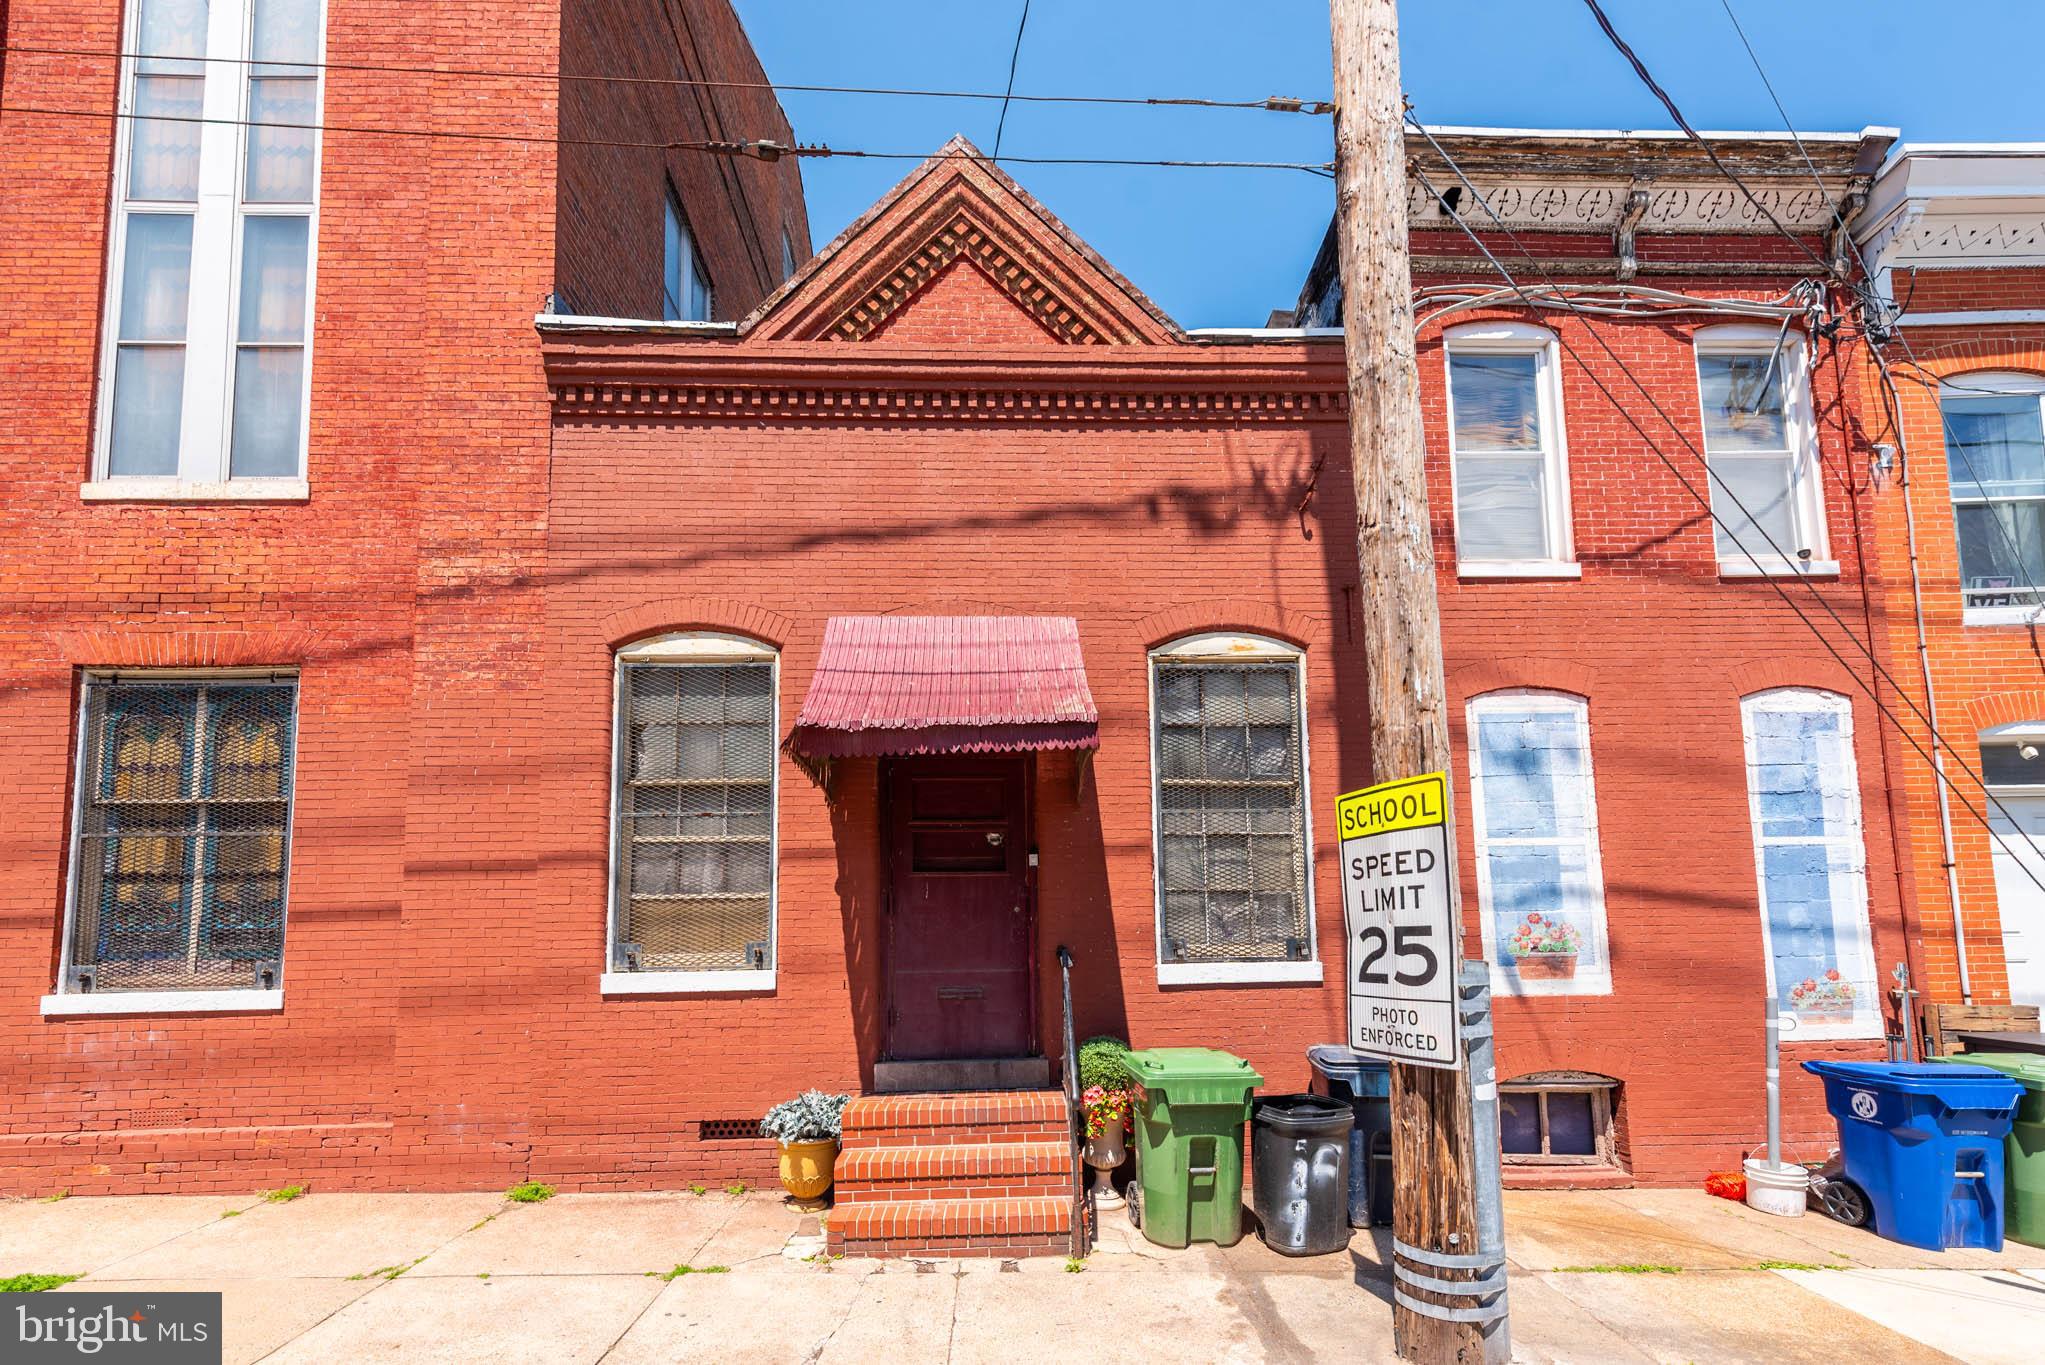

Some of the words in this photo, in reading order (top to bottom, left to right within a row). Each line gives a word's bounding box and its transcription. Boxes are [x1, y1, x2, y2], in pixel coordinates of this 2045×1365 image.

[1344, 792, 1437, 831] SCHOOL
[1352, 848, 1435, 881] SPEED
[1361, 884, 1425, 913] LIMIT
[1358, 925, 1439, 987] 25
[1372, 1006, 1418, 1026] PHOTO
[1360, 1027, 1438, 1052] ENFORCED
